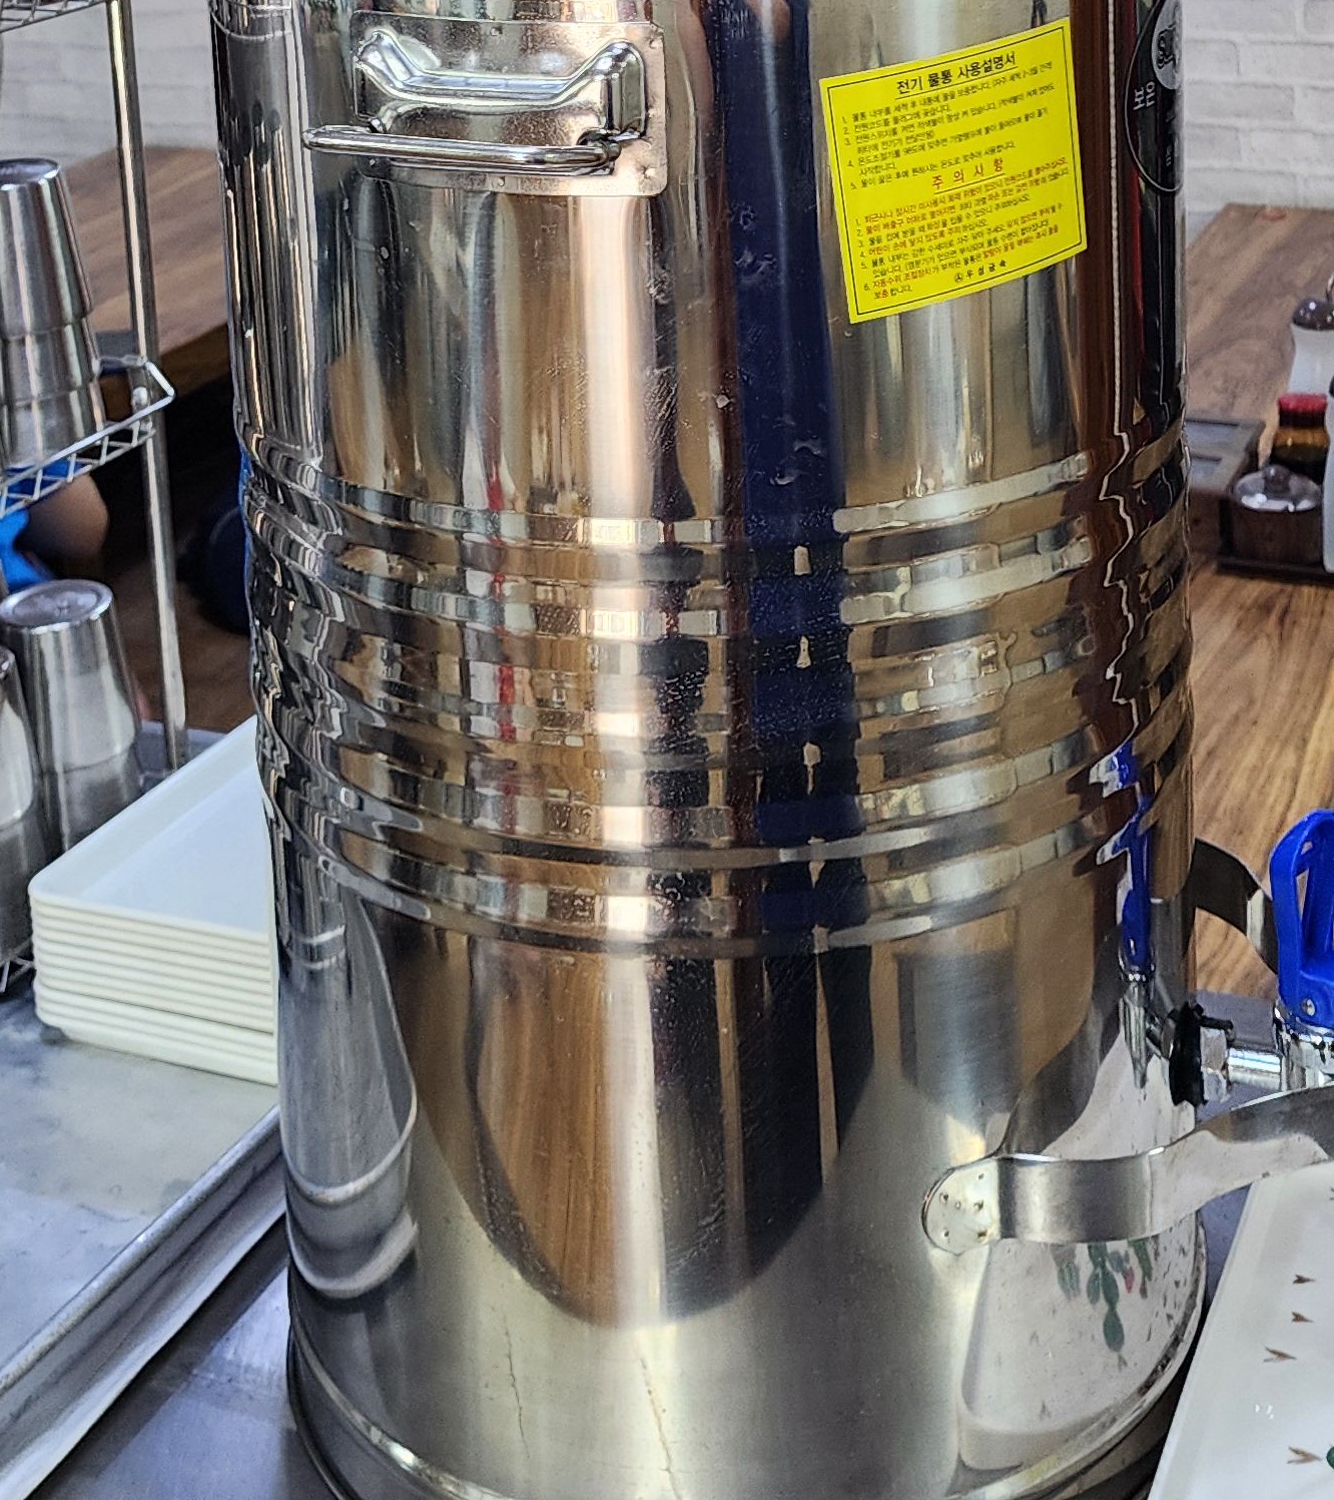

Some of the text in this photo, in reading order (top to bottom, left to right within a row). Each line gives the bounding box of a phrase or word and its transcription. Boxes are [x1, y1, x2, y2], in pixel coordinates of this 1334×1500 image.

[896, 75, 923, 96] 전기
[927, 67, 952, 88] 물통
[956, 50, 1016, 80] 사용설명서
